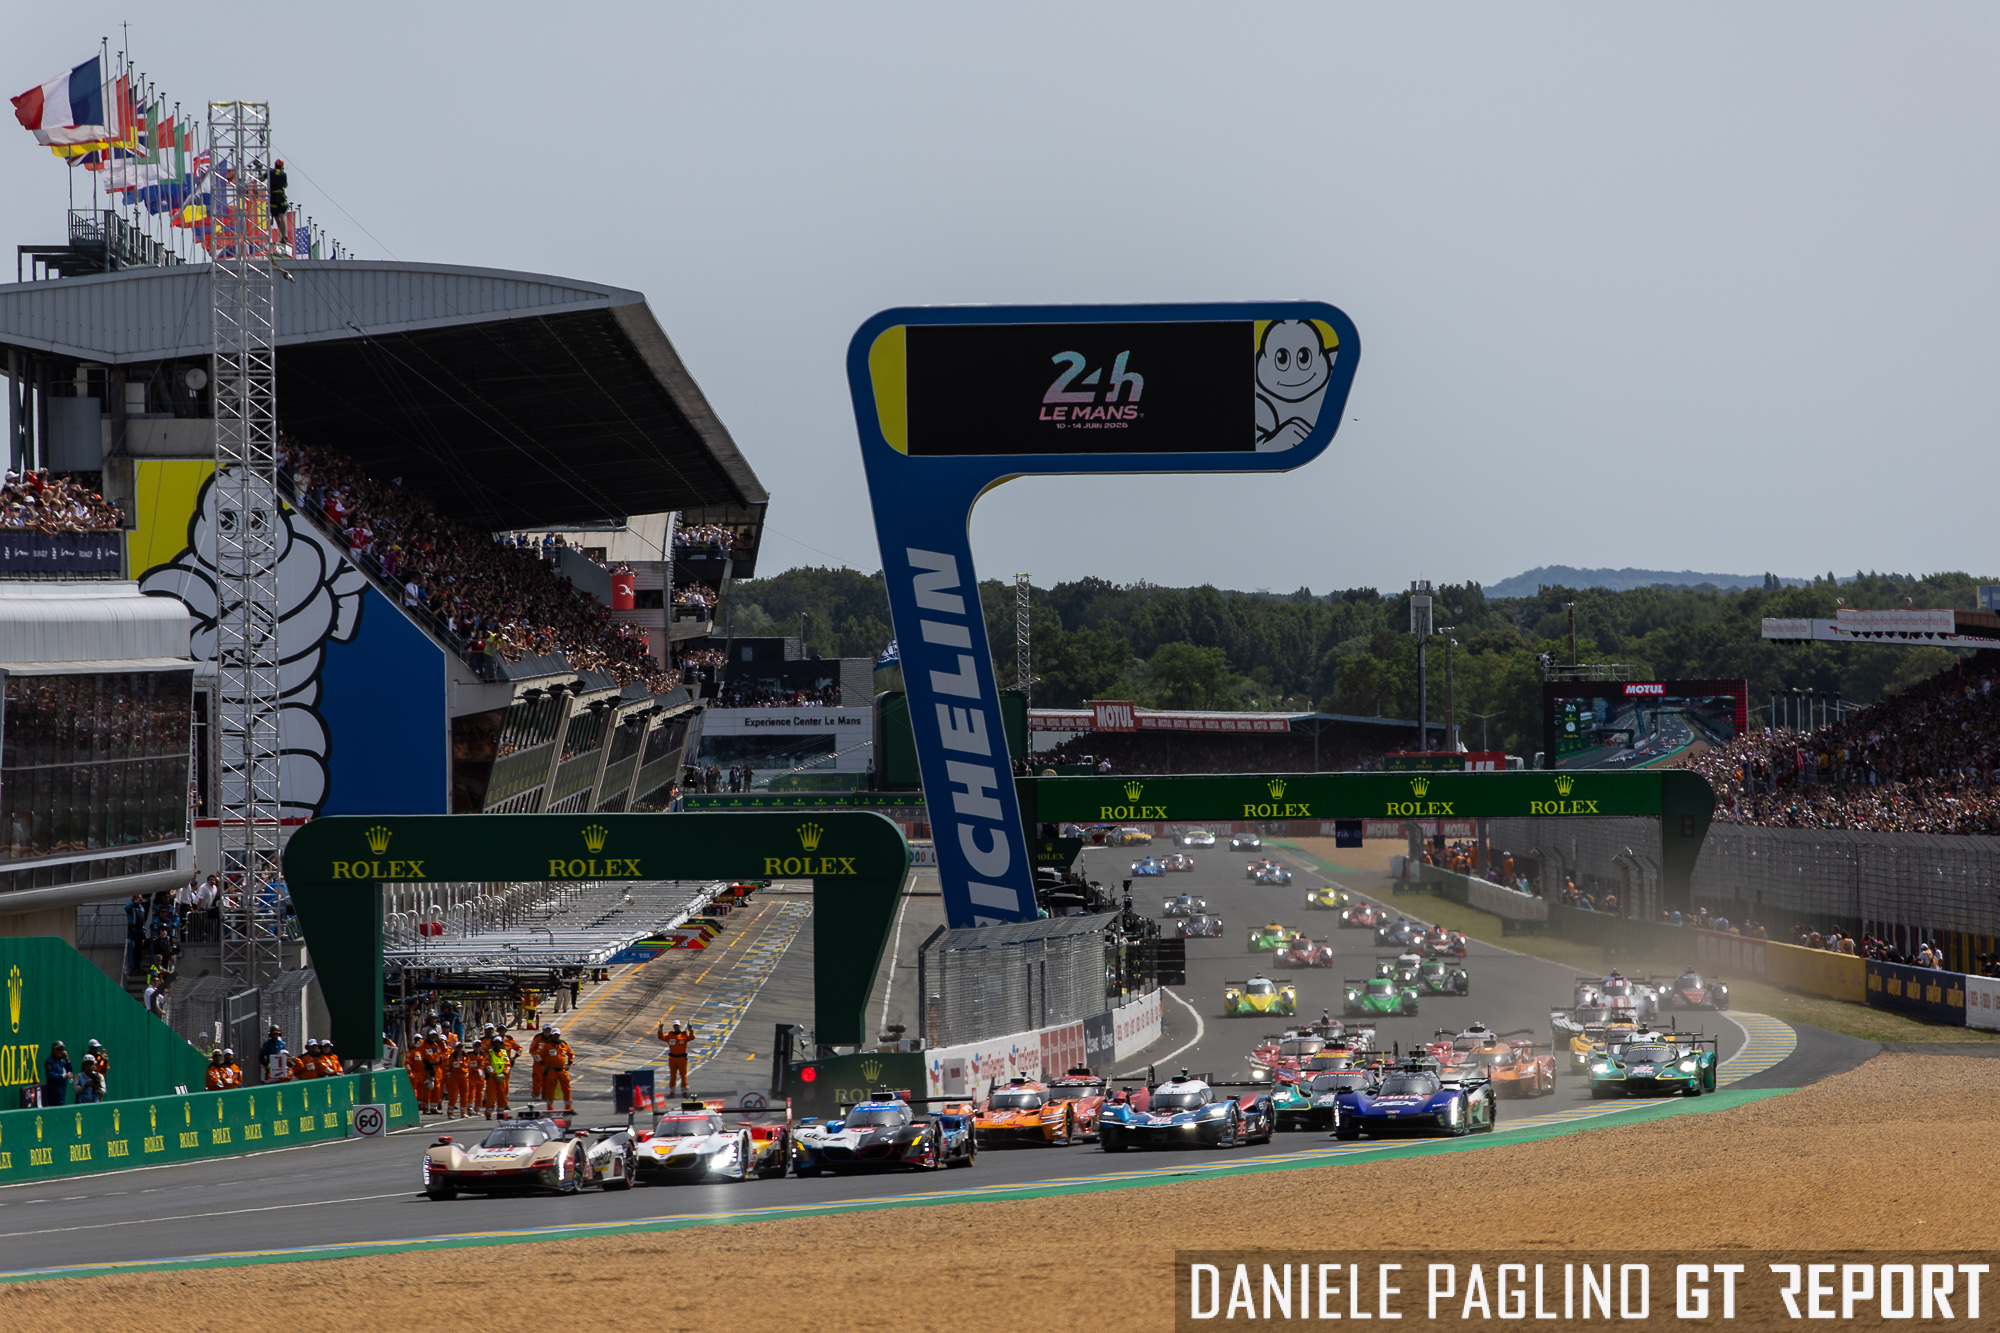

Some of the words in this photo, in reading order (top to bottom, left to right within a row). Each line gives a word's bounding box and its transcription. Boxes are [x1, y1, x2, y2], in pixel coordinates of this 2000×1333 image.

[1042, 350, 1145, 404] 24h
[1039, 406, 1068, 421] LE
[1071, 405, 1139, 420] MANS
[1625, 685, 1664, 694] MOTUL
[745, 717, 791, 728] Experience
[793, 716, 822, 726] Center
[825, 716, 835, 726] Le
[838, 716, 861, 726] Mans
[1096, 705, 1134, 728] MOTUL
[1100, 806, 1168, 819] ROLEX
[1243, 804, 1311, 817] ROLEX
[1386, 802, 1455, 816] ROLEX
[1530, 801, 1599, 815] ROLEX
[1366, 824, 1399, 836] MOTUL
[1443, 824, 1472, 836] MOTUL
[332, 861, 426, 878] ROLEX
[549, 859, 641, 877] ROLEX
[764, 857, 857, 875] ROLEX
[0, 1044, 40, 1087] OLEX
[834, 1088, 908, 1104] ROL
[390, 1103, 402, 1117] ROLEX
[273, 1120, 290, 1136] ROLEX
[300, 1116, 314, 1132] ROLEX
[324, 1112, 338, 1128] ROLEX
[359, 1114, 378, 1128] 60
[180, 1131, 199, 1148] ROLEX
[212, 1127, 231, 1144] ROLEX
[245, 1124, 262, 1140] ROLEX
[108, 1140, 129, 1157] ROLEX
[144, 1135, 165, 1153] ROLEX
[30, 1148, 53, 1166] ROLEX
[70, 1144, 92, 1162] ROLEX
